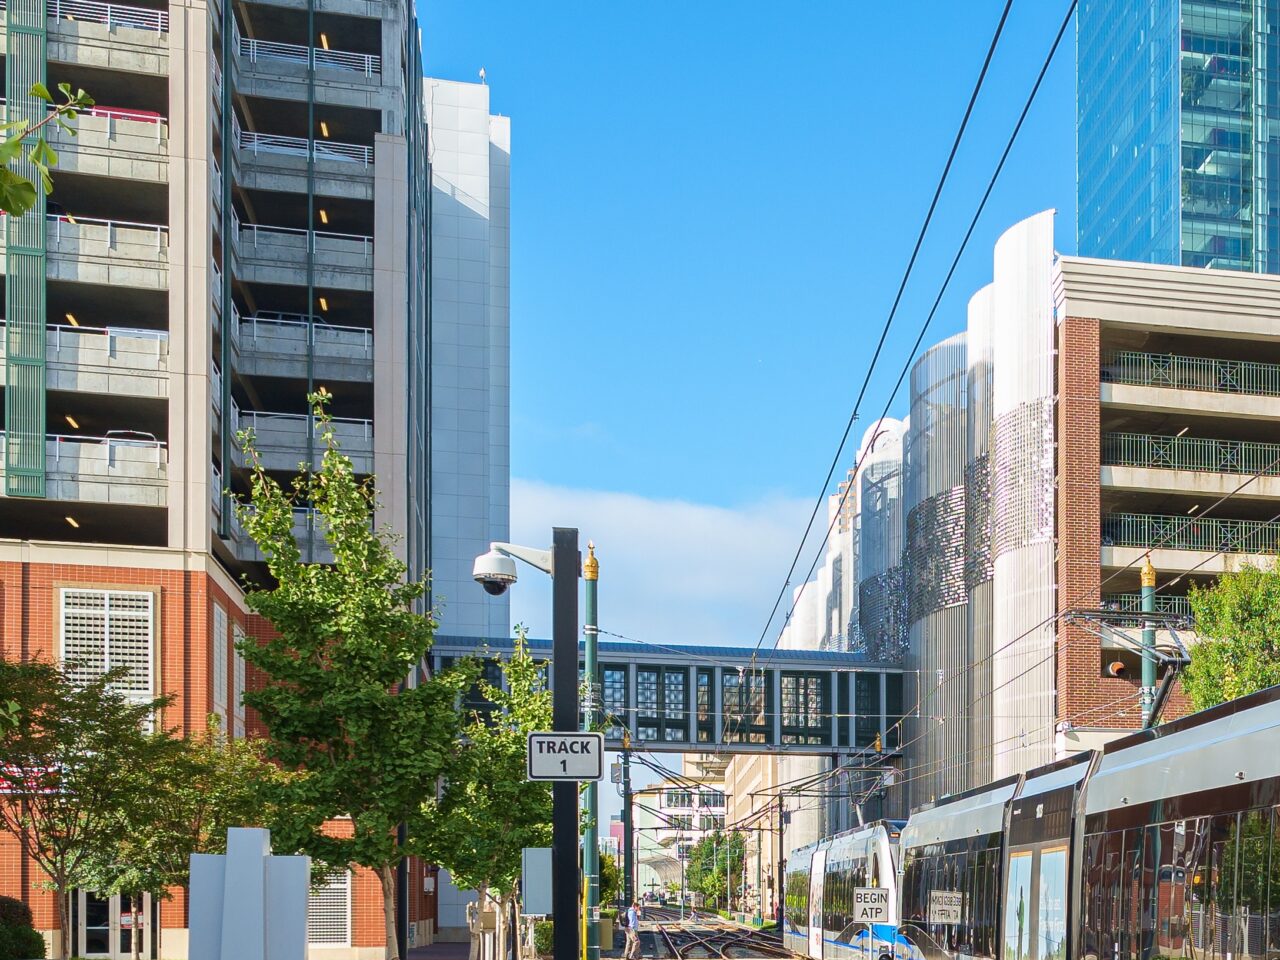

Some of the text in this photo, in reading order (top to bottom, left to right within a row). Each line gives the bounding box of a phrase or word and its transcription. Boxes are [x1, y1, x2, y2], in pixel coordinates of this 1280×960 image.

[536, 740, 591, 754] TRACK
[560, 759, 567, 772] 1
[856, 892, 888, 904] BEGIN
[860, 907, 883, 918] ATP
